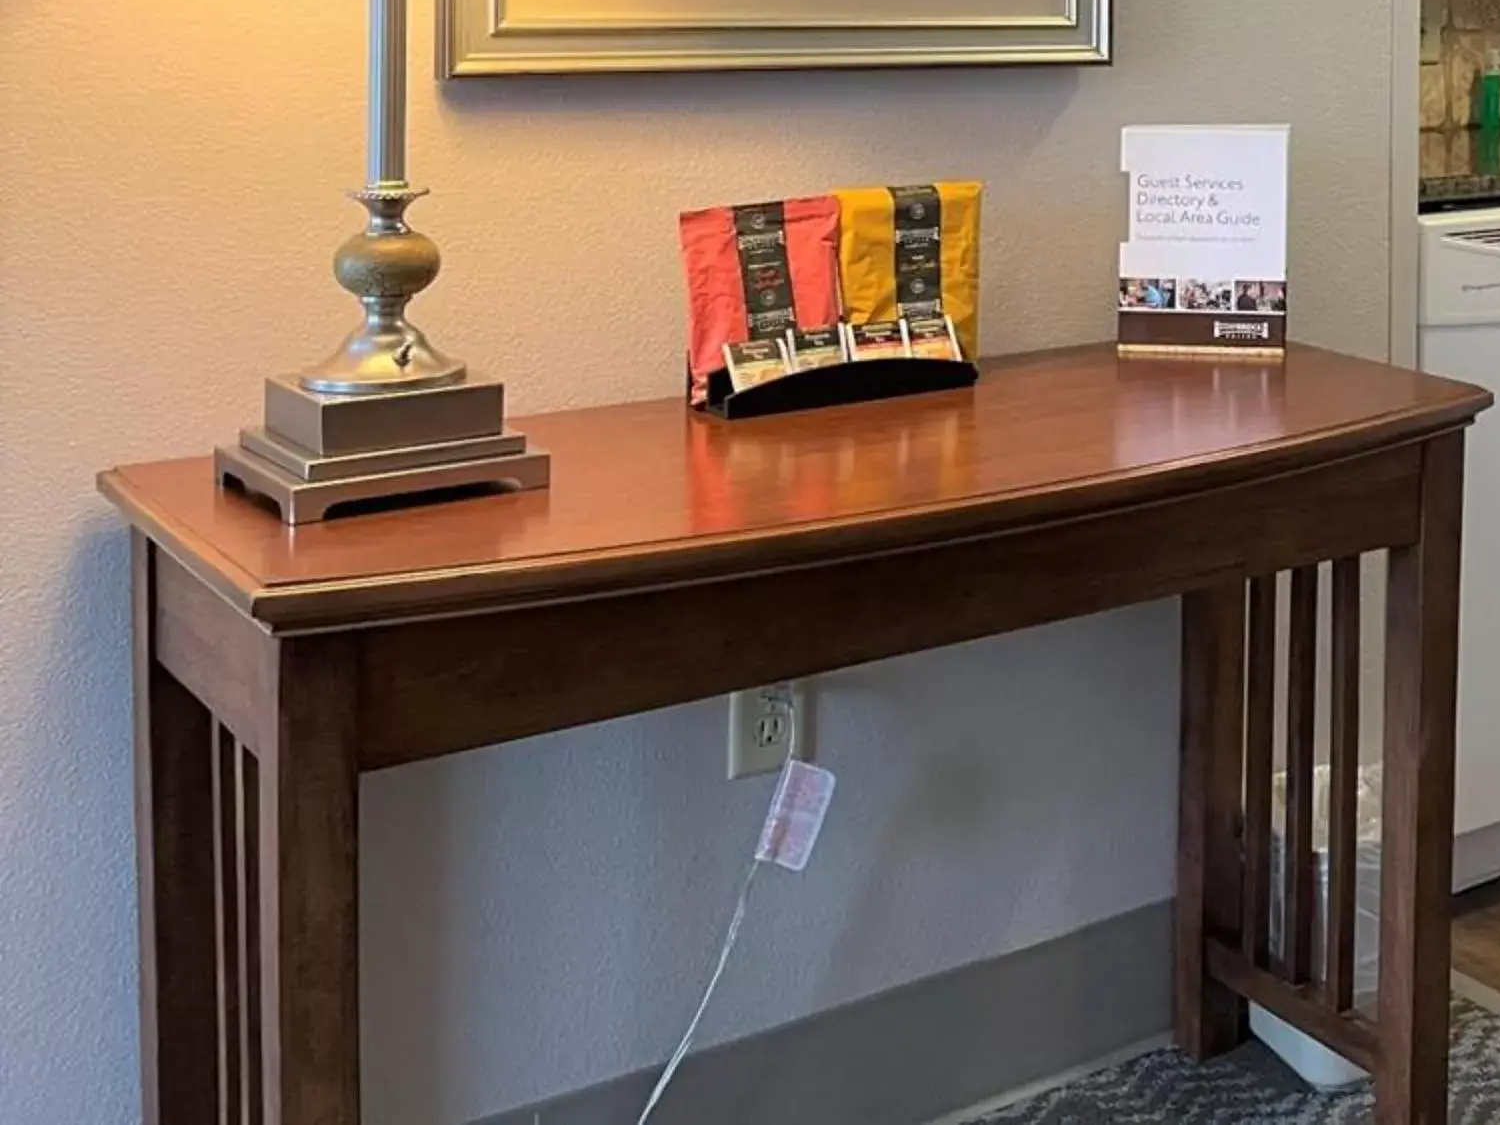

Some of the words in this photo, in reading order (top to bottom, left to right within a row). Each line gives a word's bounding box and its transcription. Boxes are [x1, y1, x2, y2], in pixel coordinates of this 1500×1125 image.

[1137, 174, 1180, 189] Guest
[1185, 174, 1244, 191] Services
[1136, 191, 1204, 210] Directory
[1207, 193, 1220, 208] &
[1136, 210, 1176, 224] Local
[1179, 210, 1213, 225] Area
[1217, 211, 1261, 227] Guide
